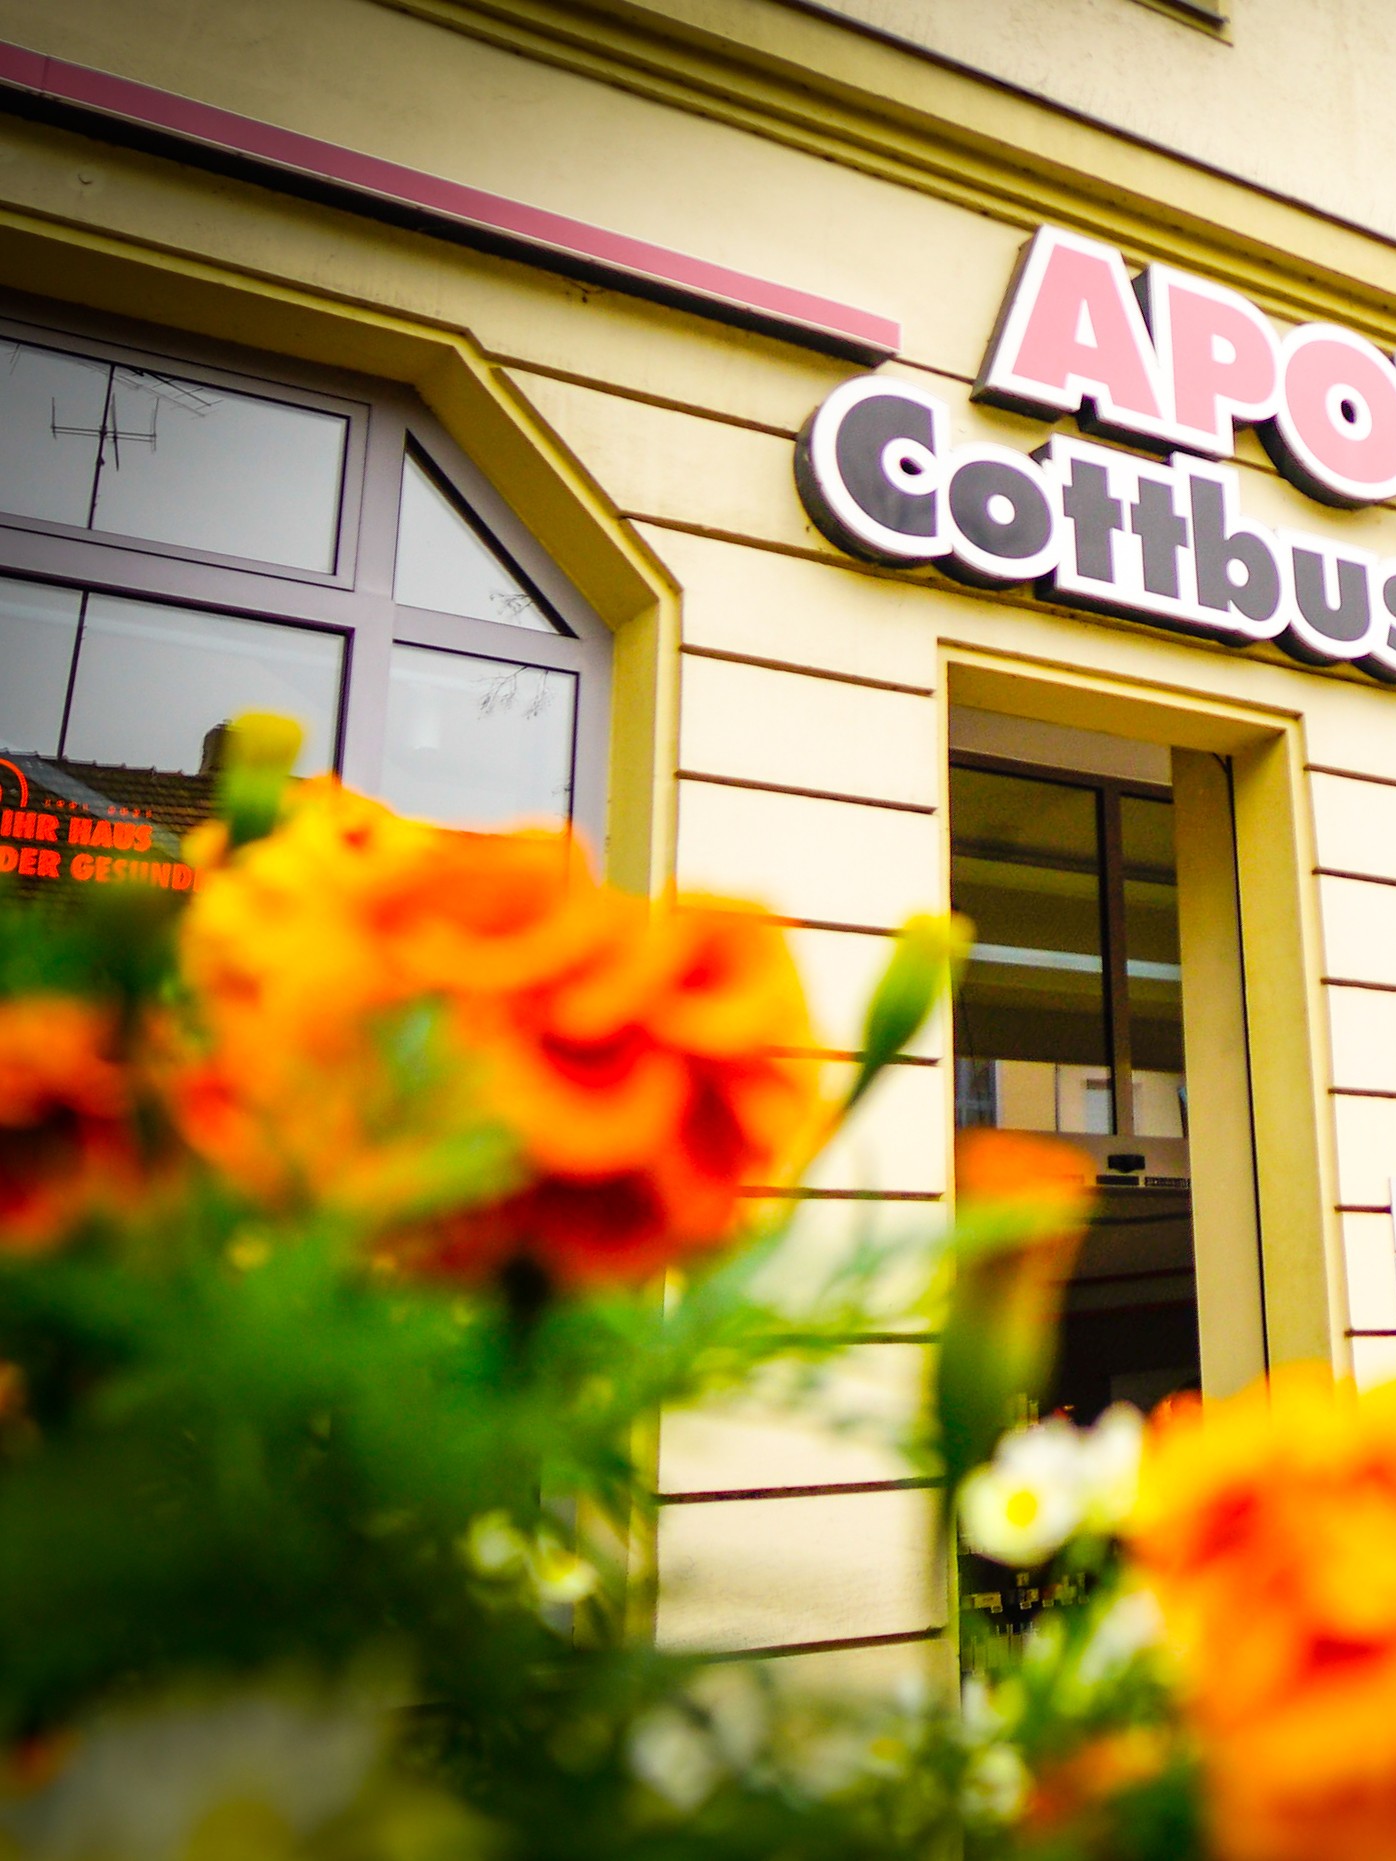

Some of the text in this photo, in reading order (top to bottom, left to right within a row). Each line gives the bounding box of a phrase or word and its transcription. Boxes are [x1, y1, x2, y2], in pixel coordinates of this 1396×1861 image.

[0, 808, 60, 843] IHR
[68, 816, 154, 853] HAUS
[0, 844, 203, 893] DER GESUND
